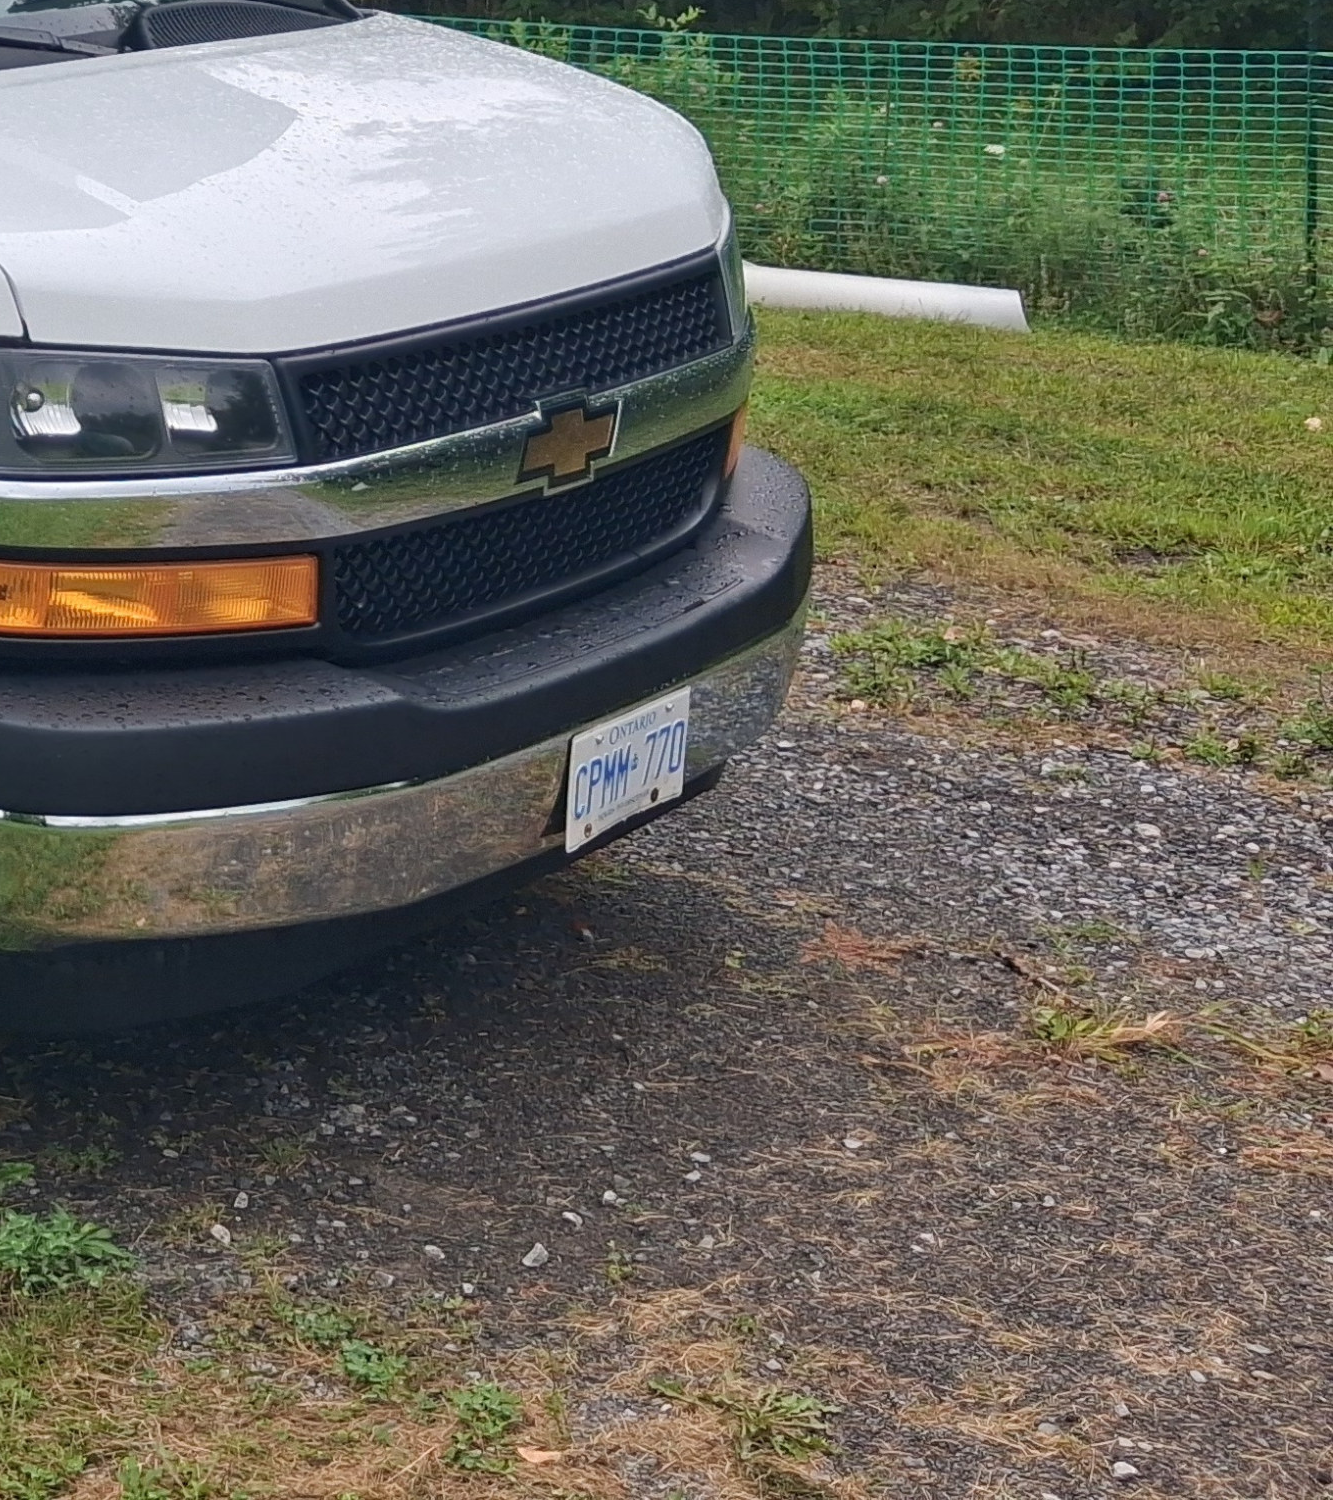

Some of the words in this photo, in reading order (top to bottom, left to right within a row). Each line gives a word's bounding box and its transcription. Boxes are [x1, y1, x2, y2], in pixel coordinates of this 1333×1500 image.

[609, 711, 657, 745] ONTARIO
[574, 742, 632, 820] CPMM
[643, 720, 685, 786] 770
